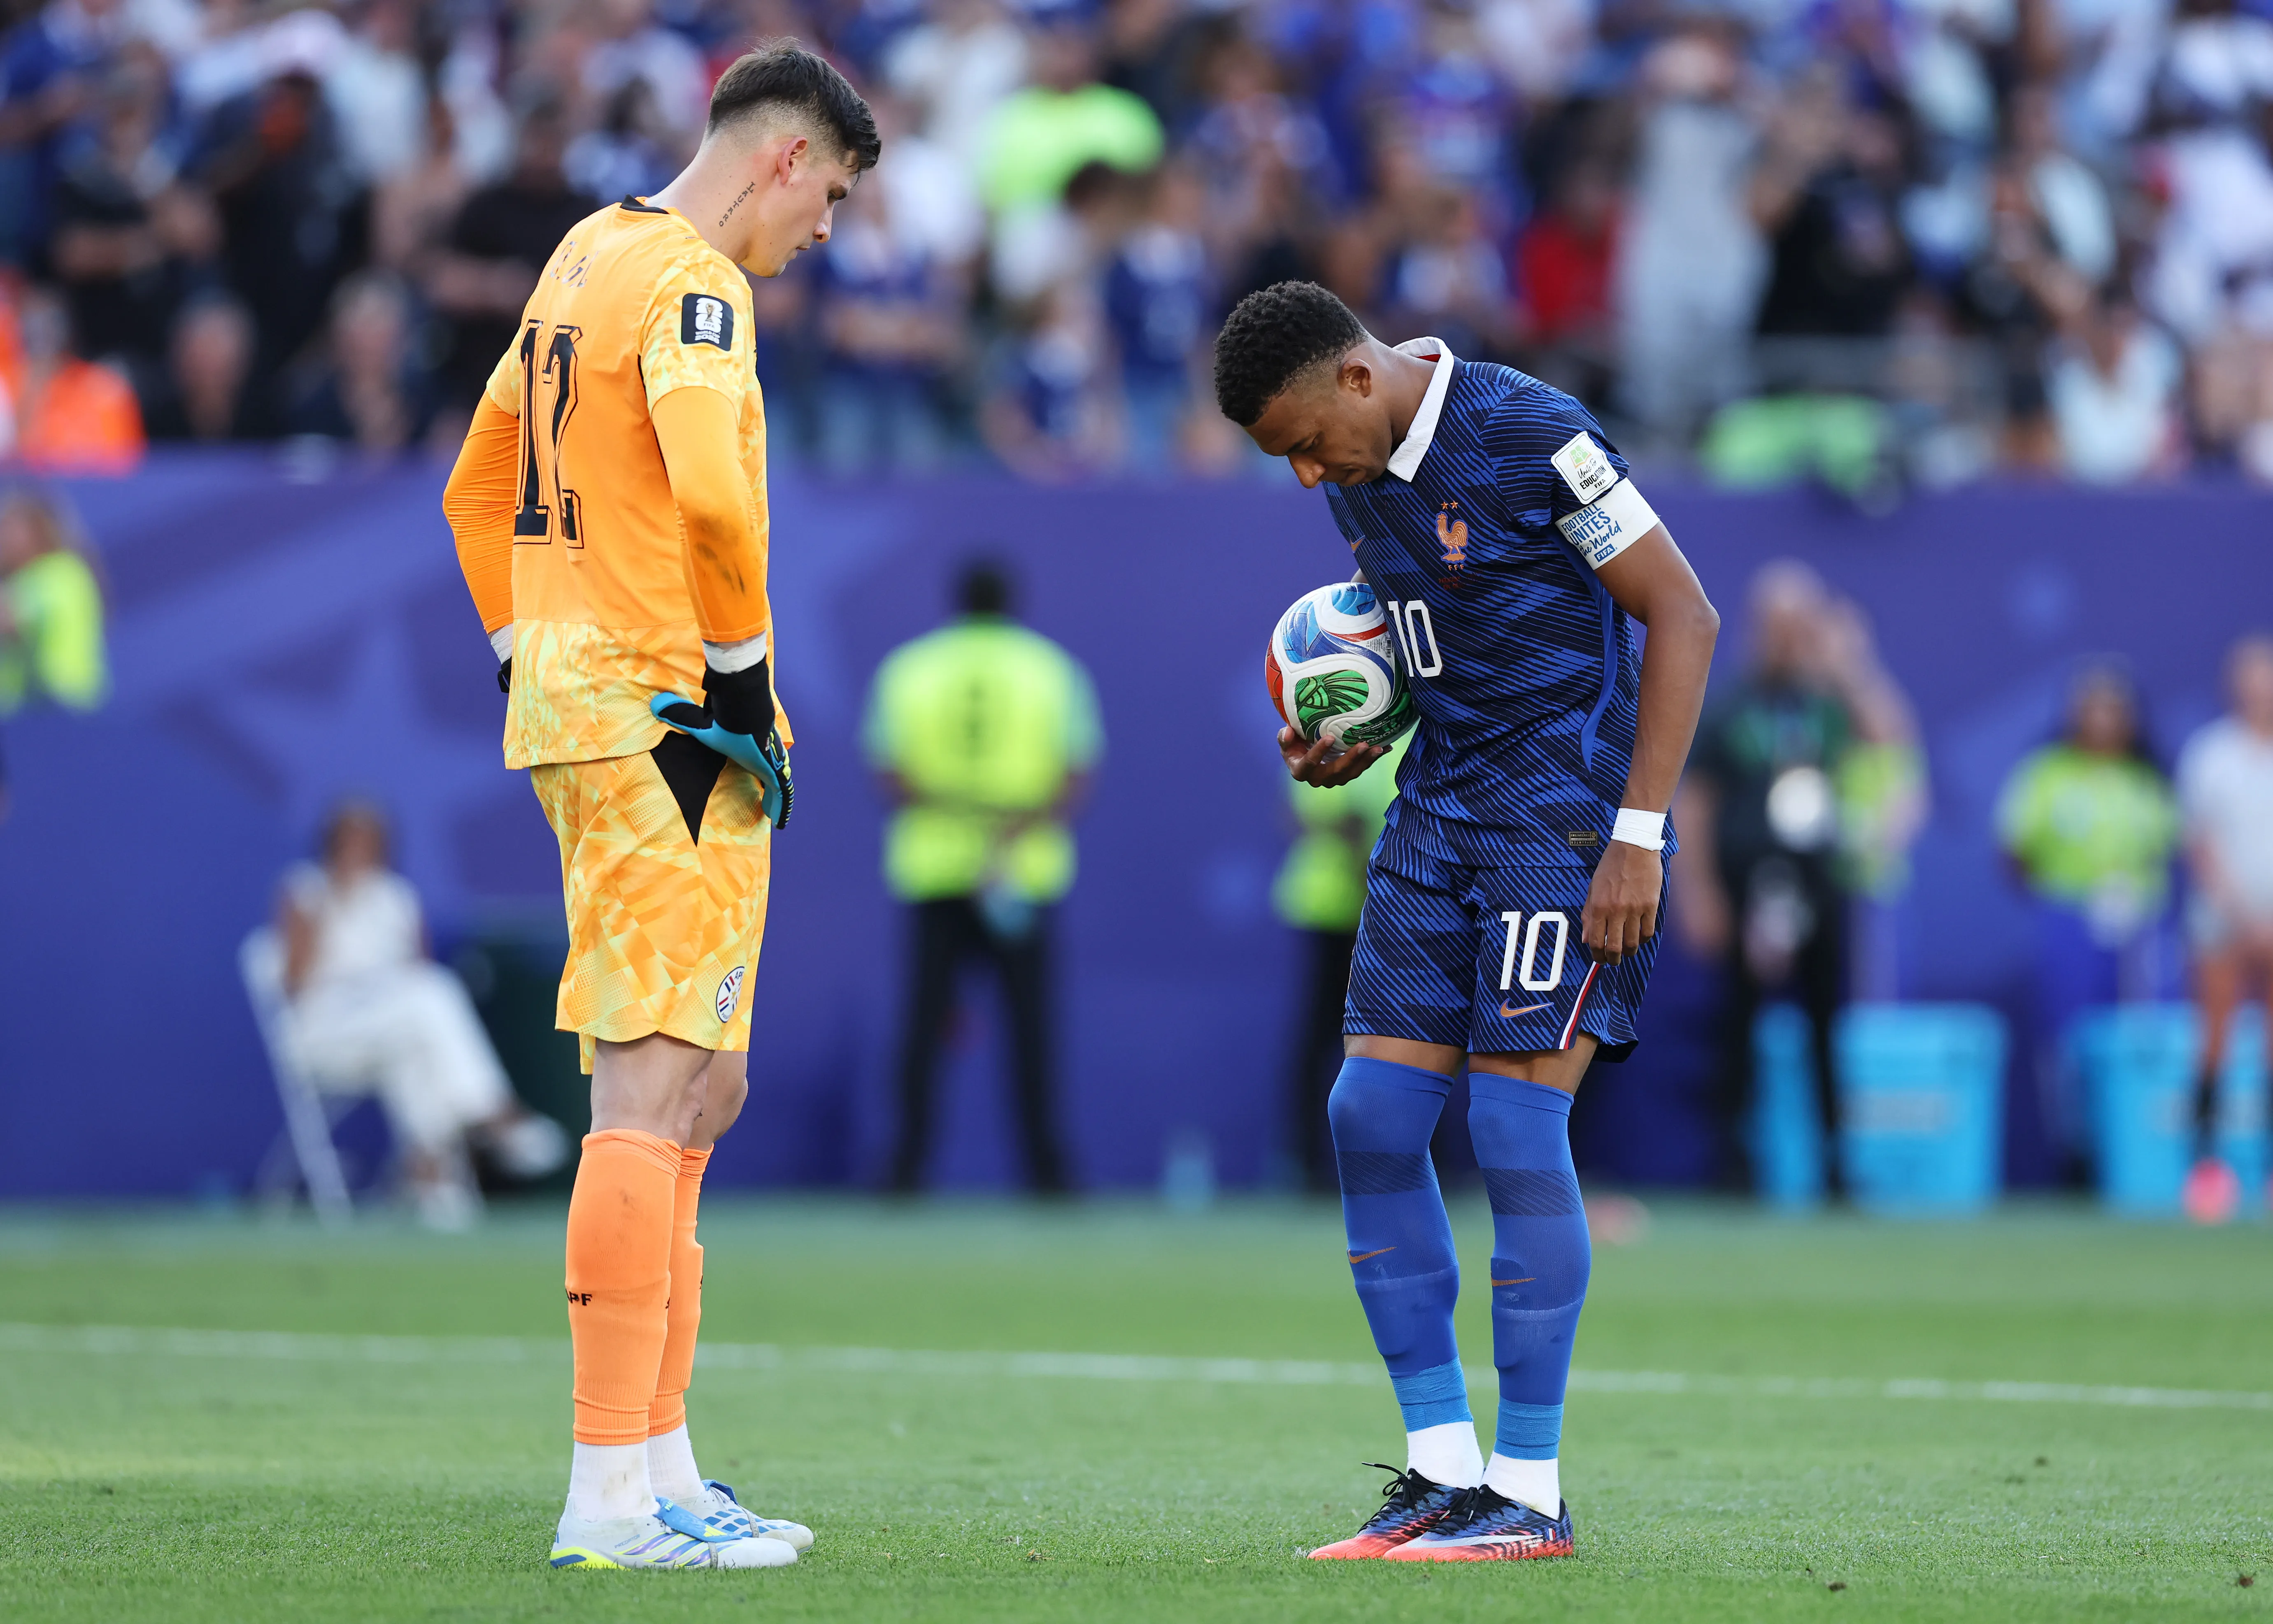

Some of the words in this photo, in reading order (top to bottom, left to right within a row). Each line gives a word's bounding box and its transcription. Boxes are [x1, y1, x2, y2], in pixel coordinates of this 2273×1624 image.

[719, 181, 756, 227] LAUTARO
[513, 319, 584, 549] 12
[1577, 464, 1592, 479] Unite
[1580, 465, 1606, 490] EDUCATION
[1594, 479, 1606, 488] FIFA
[1561, 503, 1601, 534] FOOTBALL
[1568, 511, 1611, 546] UNITES
[1580, 545, 1592, 557] the
[1589, 520, 1622, 549] World
[1596, 546, 1614, 560] FIFA
[1387, 600, 1443, 678] 10
[1499, 911, 1570, 991] 10
